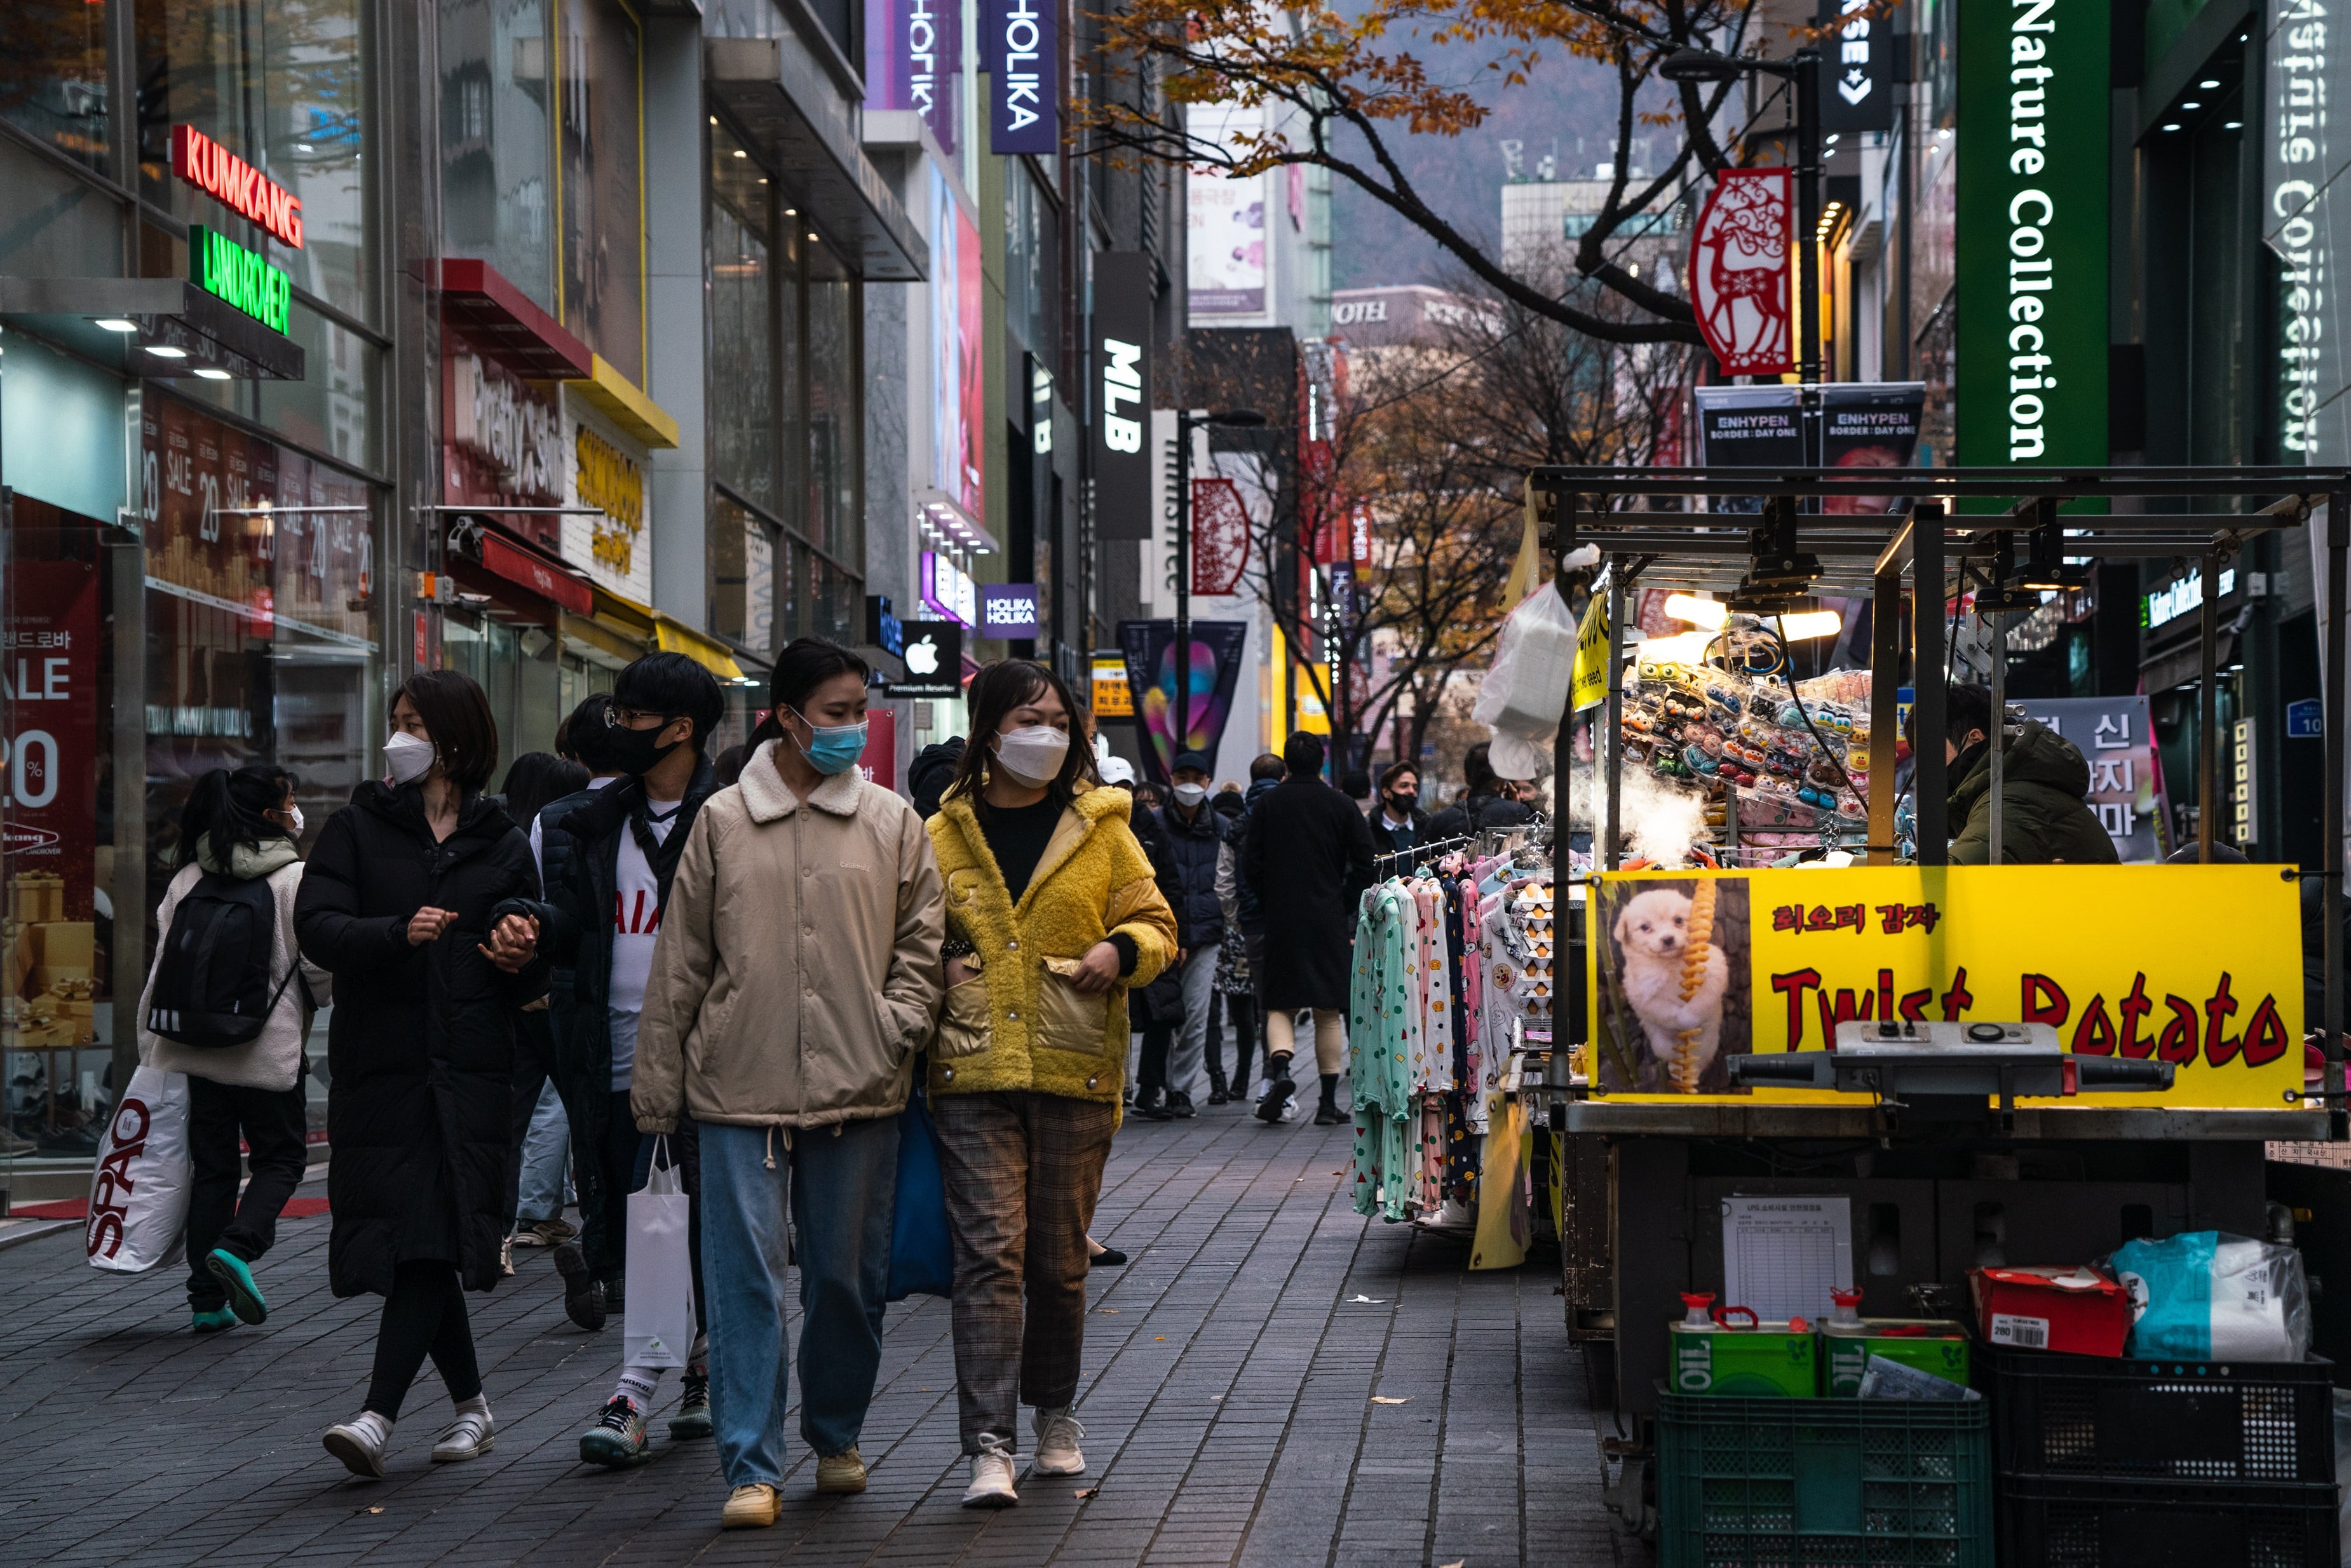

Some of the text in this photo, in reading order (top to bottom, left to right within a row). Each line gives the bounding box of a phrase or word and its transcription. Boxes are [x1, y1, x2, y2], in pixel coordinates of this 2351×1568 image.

[1006, 0, 1040, 132] HOLIKA
[187, 125, 303, 248] KUMKANG
[2009, 0, 2057, 461] Nature Collection
[203, 230, 290, 335] LANDROVER
[1104, 338, 1142, 454] MLB
[1838, 413, 1909, 425] ENHYPEN
[1718, 415, 1789, 429] ENHYPEN
[1777, 427, 1798, 437] ONE
[167, 449, 192, 496] SALE
[200, 471, 219, 543] 20
[310, 513, 326, 579] 20
[986, 598, 1034, 612] HOLIKA
[986, 611, 1034, 625] HOLIKA
[888, 684, 956, 693] Premium Reseller
[1588, 666, 1602, 687] seed
[1772, 903, 1941, 935] 회오리 감자
[2020, 969, 2290, 1070] Potato
[86, 1098, 150, 1261] SPAO
[1994, 1326, 2010, 1337] 280
[1679, 1339, 1712, 1390] OIL
